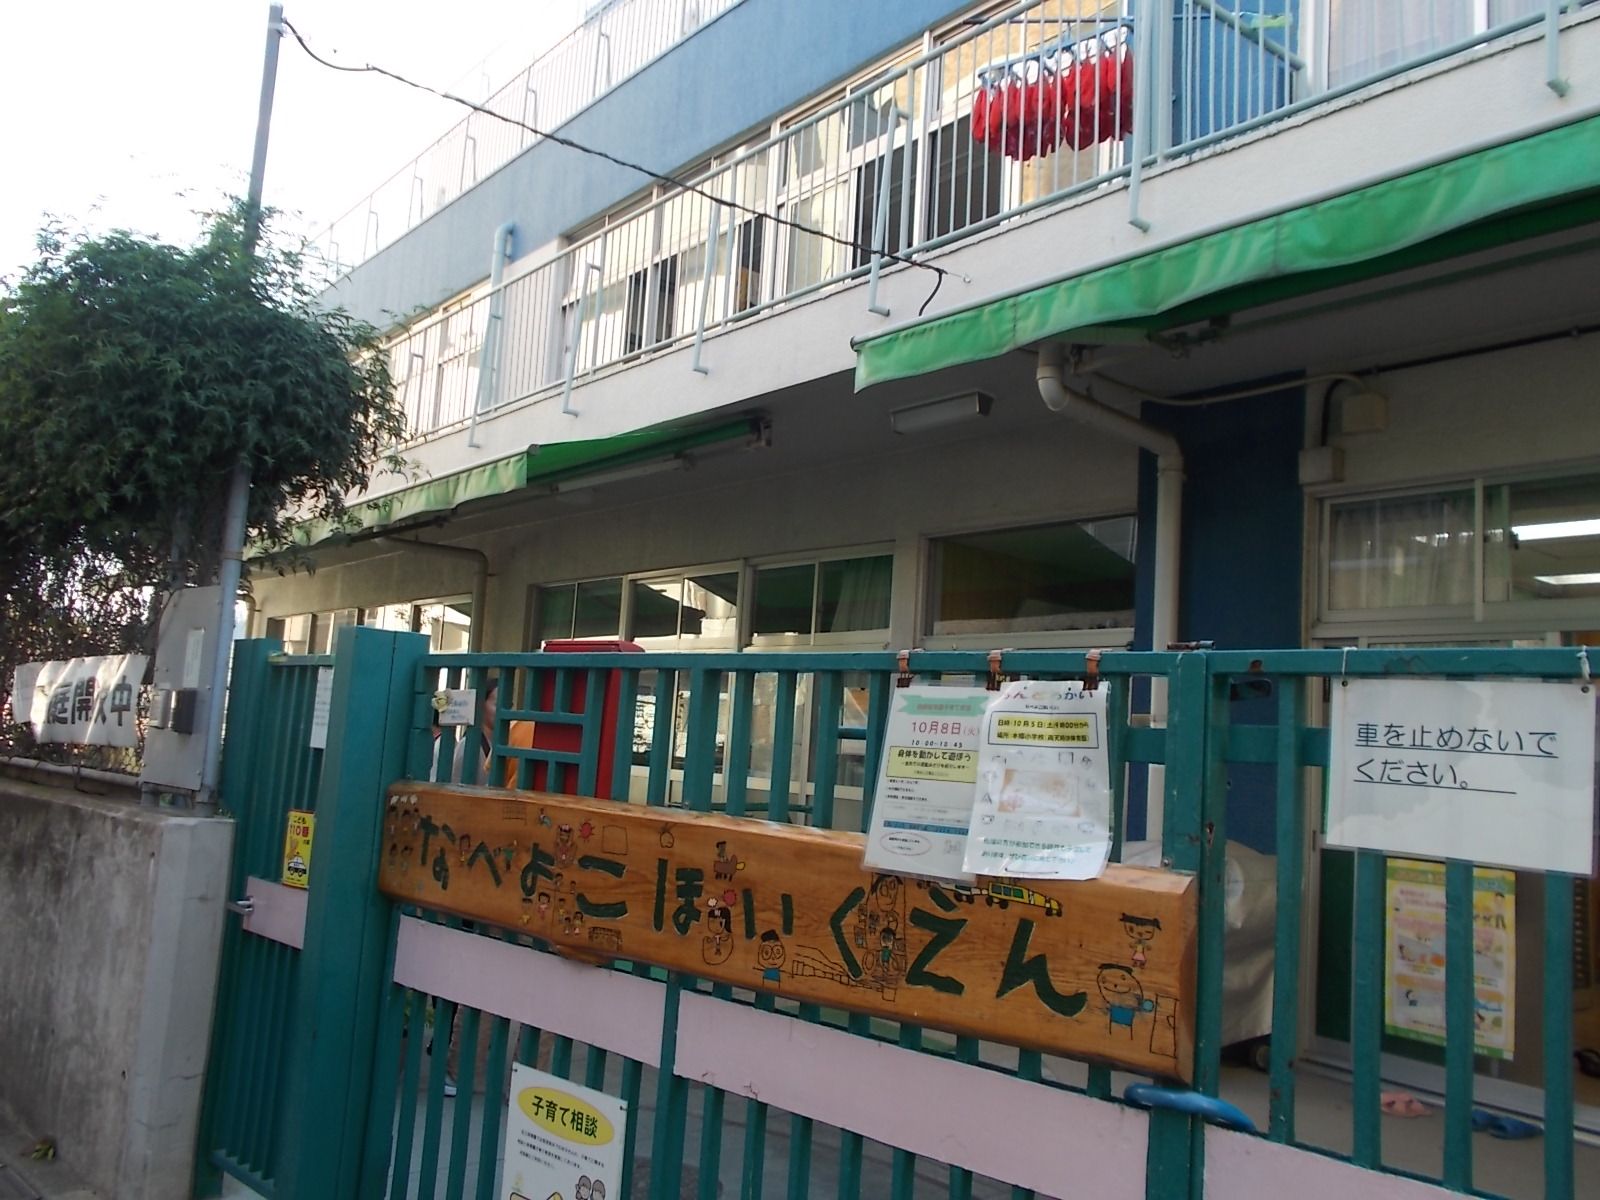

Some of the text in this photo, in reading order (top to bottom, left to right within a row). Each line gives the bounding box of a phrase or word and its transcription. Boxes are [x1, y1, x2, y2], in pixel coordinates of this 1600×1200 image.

[37, 675, 132, 727] 庭開中
[1355, 723, 1558, 755] 車を止めないで
[1356, 758, 1469, 789] ください。
[531, 1095, 598, 1139] 子育て相談
